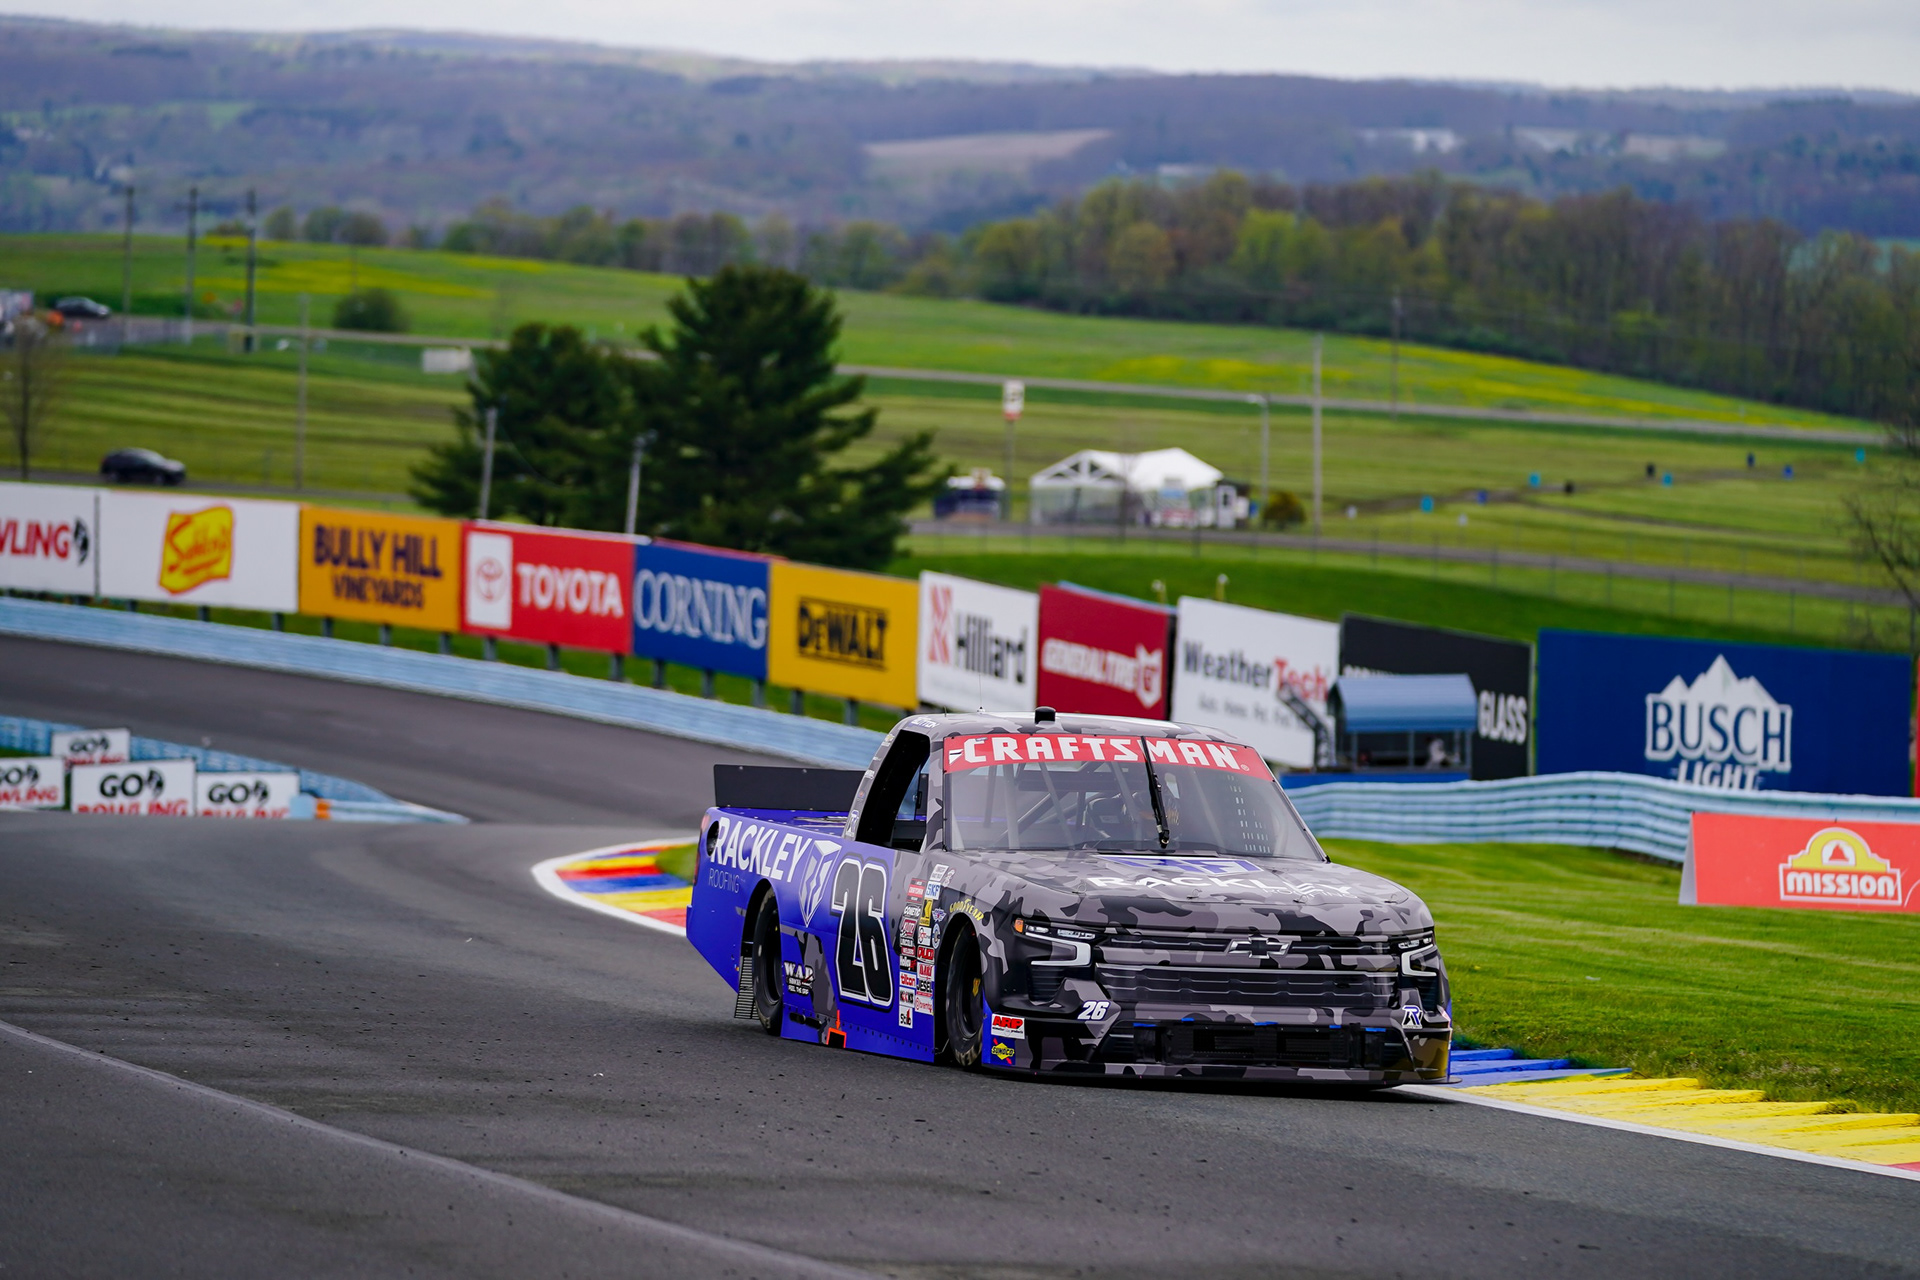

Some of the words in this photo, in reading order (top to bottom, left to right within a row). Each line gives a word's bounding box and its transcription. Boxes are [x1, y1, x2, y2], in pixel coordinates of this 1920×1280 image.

[313, 524, 387, 571] BULLY
[392, 531, 443, 578] HILL
[332, 575, 426, 609] VINEYARDS
[517, 563, 624, 618] TOYOTA
[634, 569, 767, 649] CORNING
[955, 612, 1028, 684] Hilliard
[1184, 641, 1329, 702] WeatherTech
[1478, 690, 1528, 744] GLASS
[1648, 697, 1789, 768] BUSCH
[962, 736, 1243, 769] CRAFTSMAN
[100, 774, 144, 798] GO
[1678, 759, 1760, 791] LIGHT
[208, 784, 250, 804] GO
[711, 817, 813, 883] RACKLEY
[708, 868, 740, 894] ROOFING
[926, 884, 940, 897] SKF
[1087, 876, 1353, 896] RACKLEY
[1785, 871, 1895, 898] MISSION
[949, 898, 985, 921] GOODYEAR
[831, 857, 894, 1007] 26
[917, 979, 932, 993] JESEL
[992, 1015, 1023, 1030] ARP
[1077, 1001, 1110, 1020] 26
[992, 1045, 1014, 1057] SUNOCO
